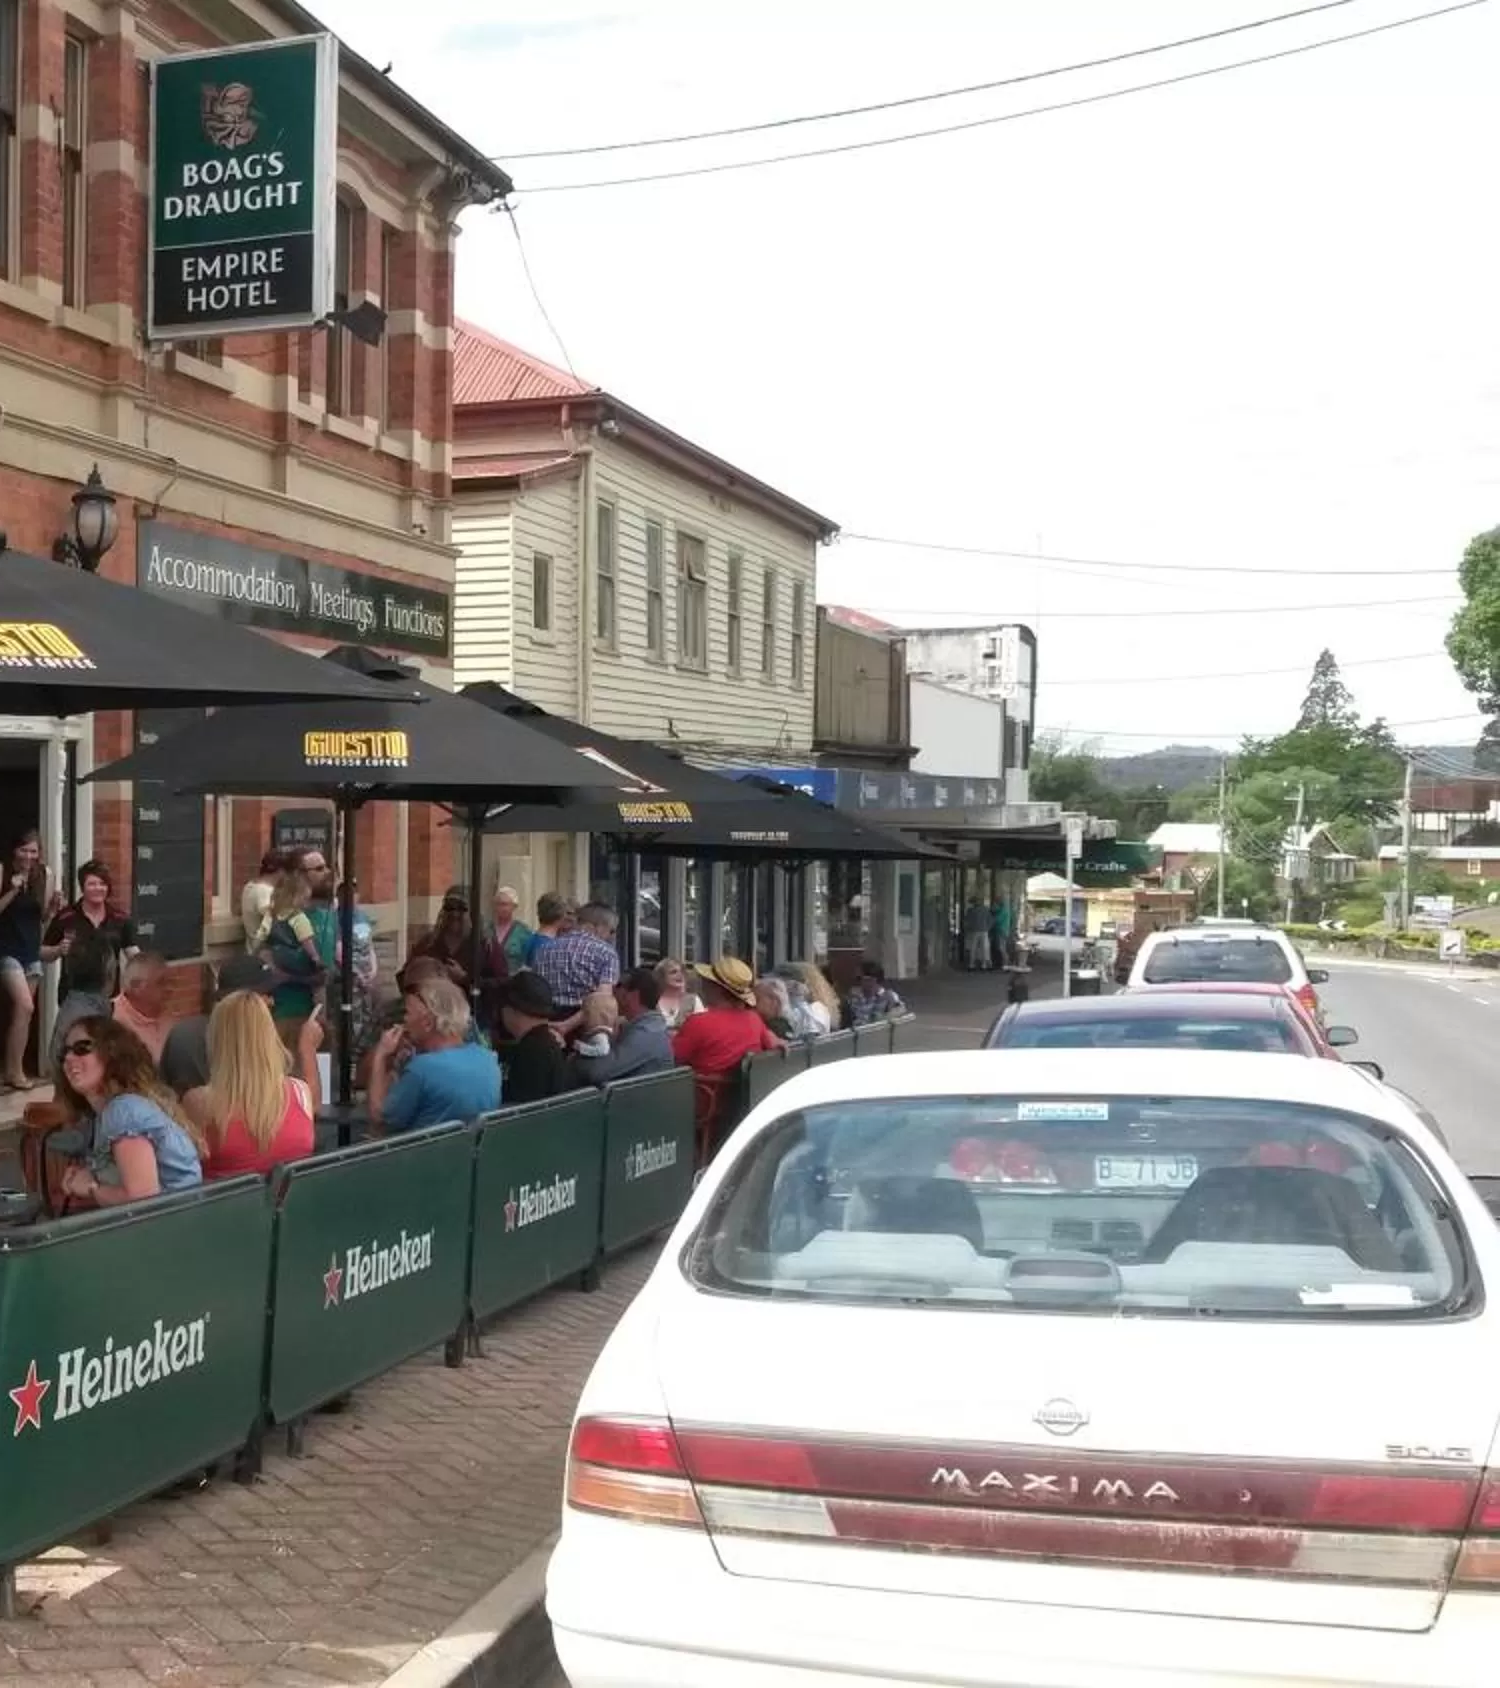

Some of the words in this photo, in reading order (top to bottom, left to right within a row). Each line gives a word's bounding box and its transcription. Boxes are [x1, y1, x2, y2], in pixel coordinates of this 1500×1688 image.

[182, 151, 285, 188] BOAG'S
[163, 181, 303, 220] DRAUGHT
[181, 248, 285, 283] EMPIRE
[186, 281, 277, 312] HOTEL
[147, 545, 300, 611] Accommodation,
[309, 581, 376, 632] Meetings,
[384, 597, 444, 639] Functions
[304, 730, 409, 759] GUSTO
[634, 1136, 677, 1178] Heineken
[518, 1173, 576, 1228] Heineken
[343, 1229, 432, 1301] Heineken
[53, 1318, 206, 1422] Heineken
[930, 1466, 1181, 1502] MAXIMA
